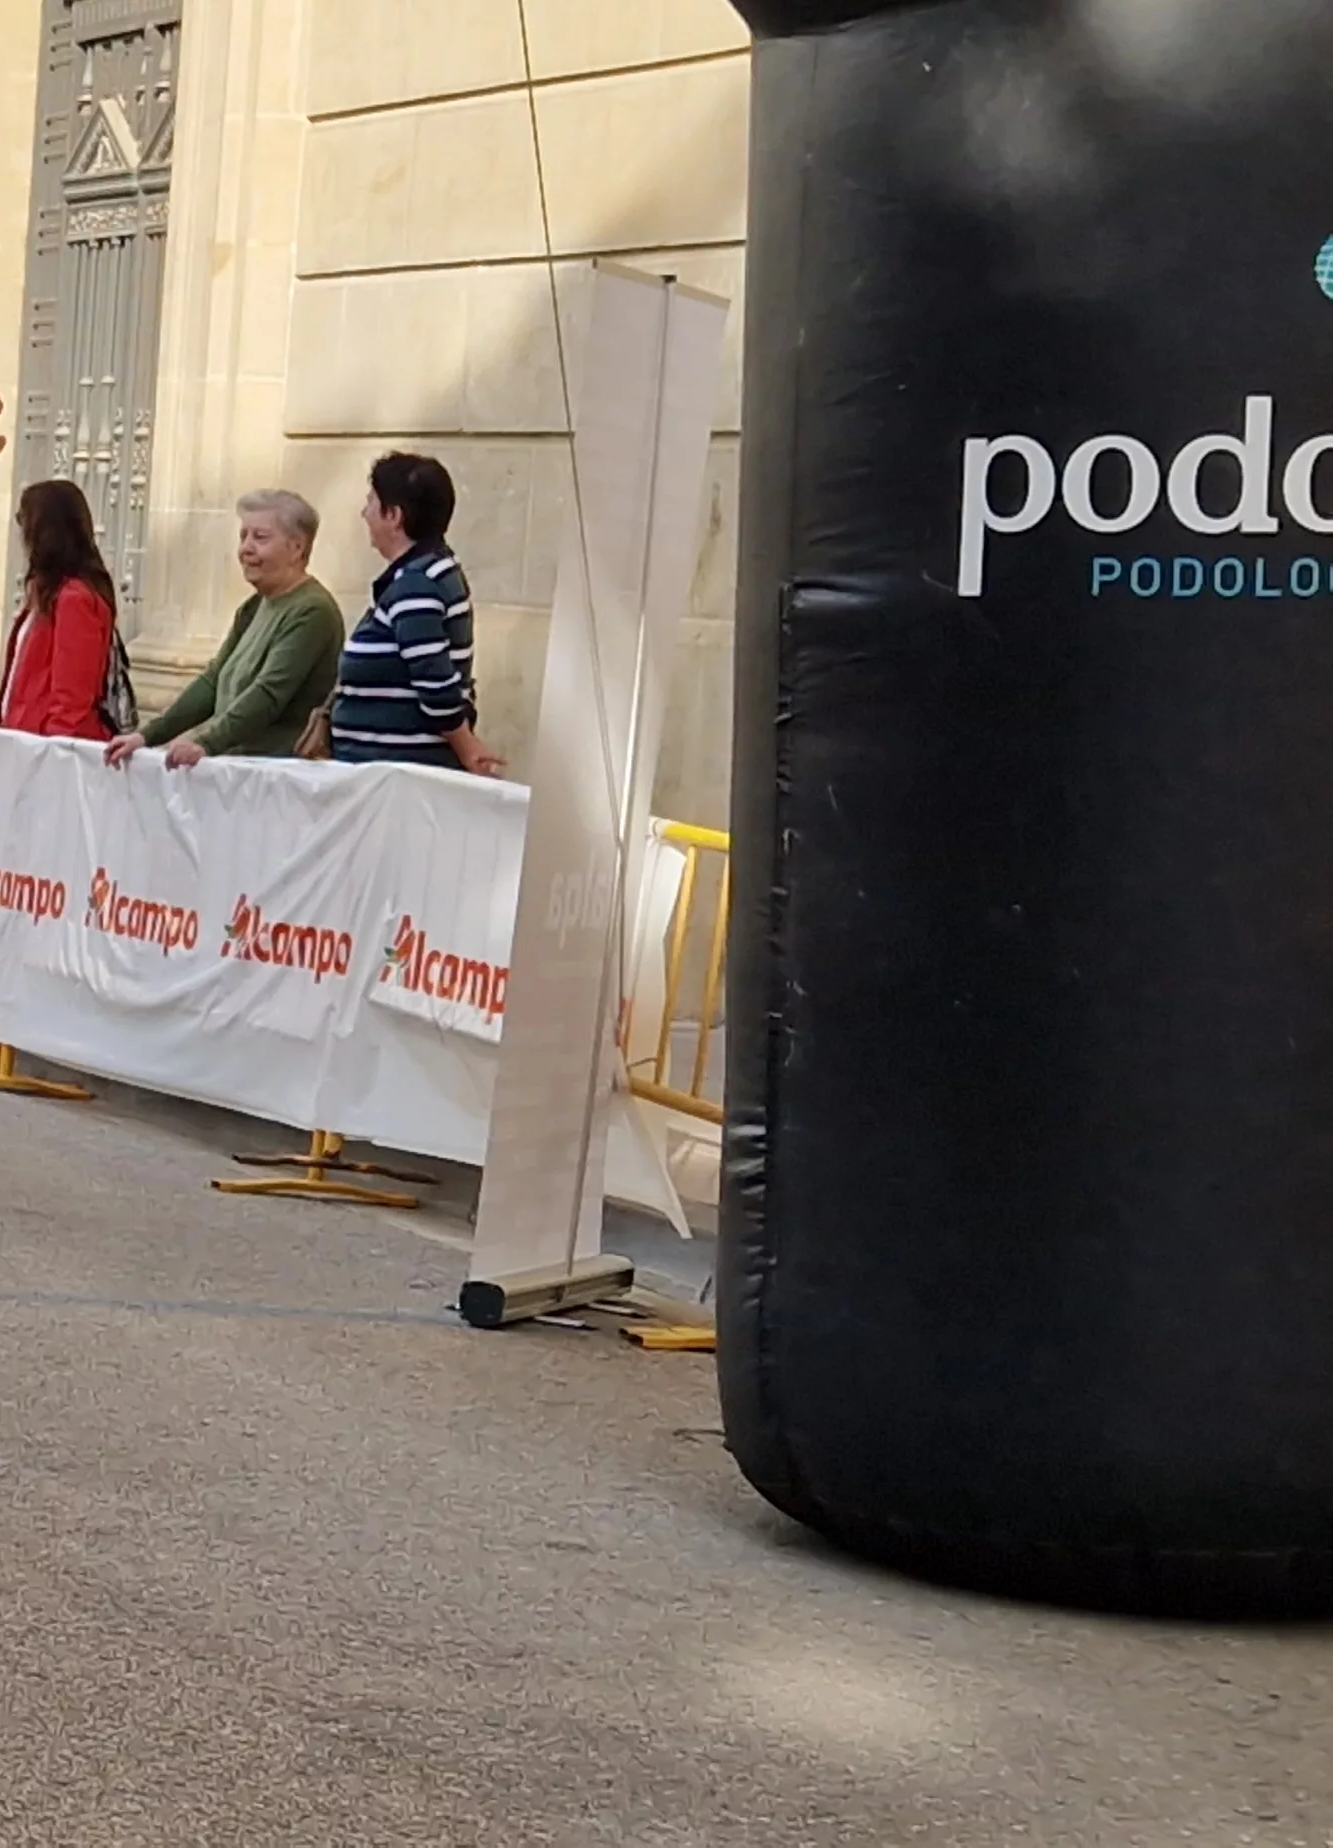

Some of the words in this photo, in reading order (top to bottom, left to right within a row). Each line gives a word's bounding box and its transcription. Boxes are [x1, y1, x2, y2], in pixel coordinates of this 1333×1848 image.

[1091, 556, 1333, 597] PODOLO
[85, 866, 199, 957] Alcampo
[220, 893, 353, 985] Alcampo
